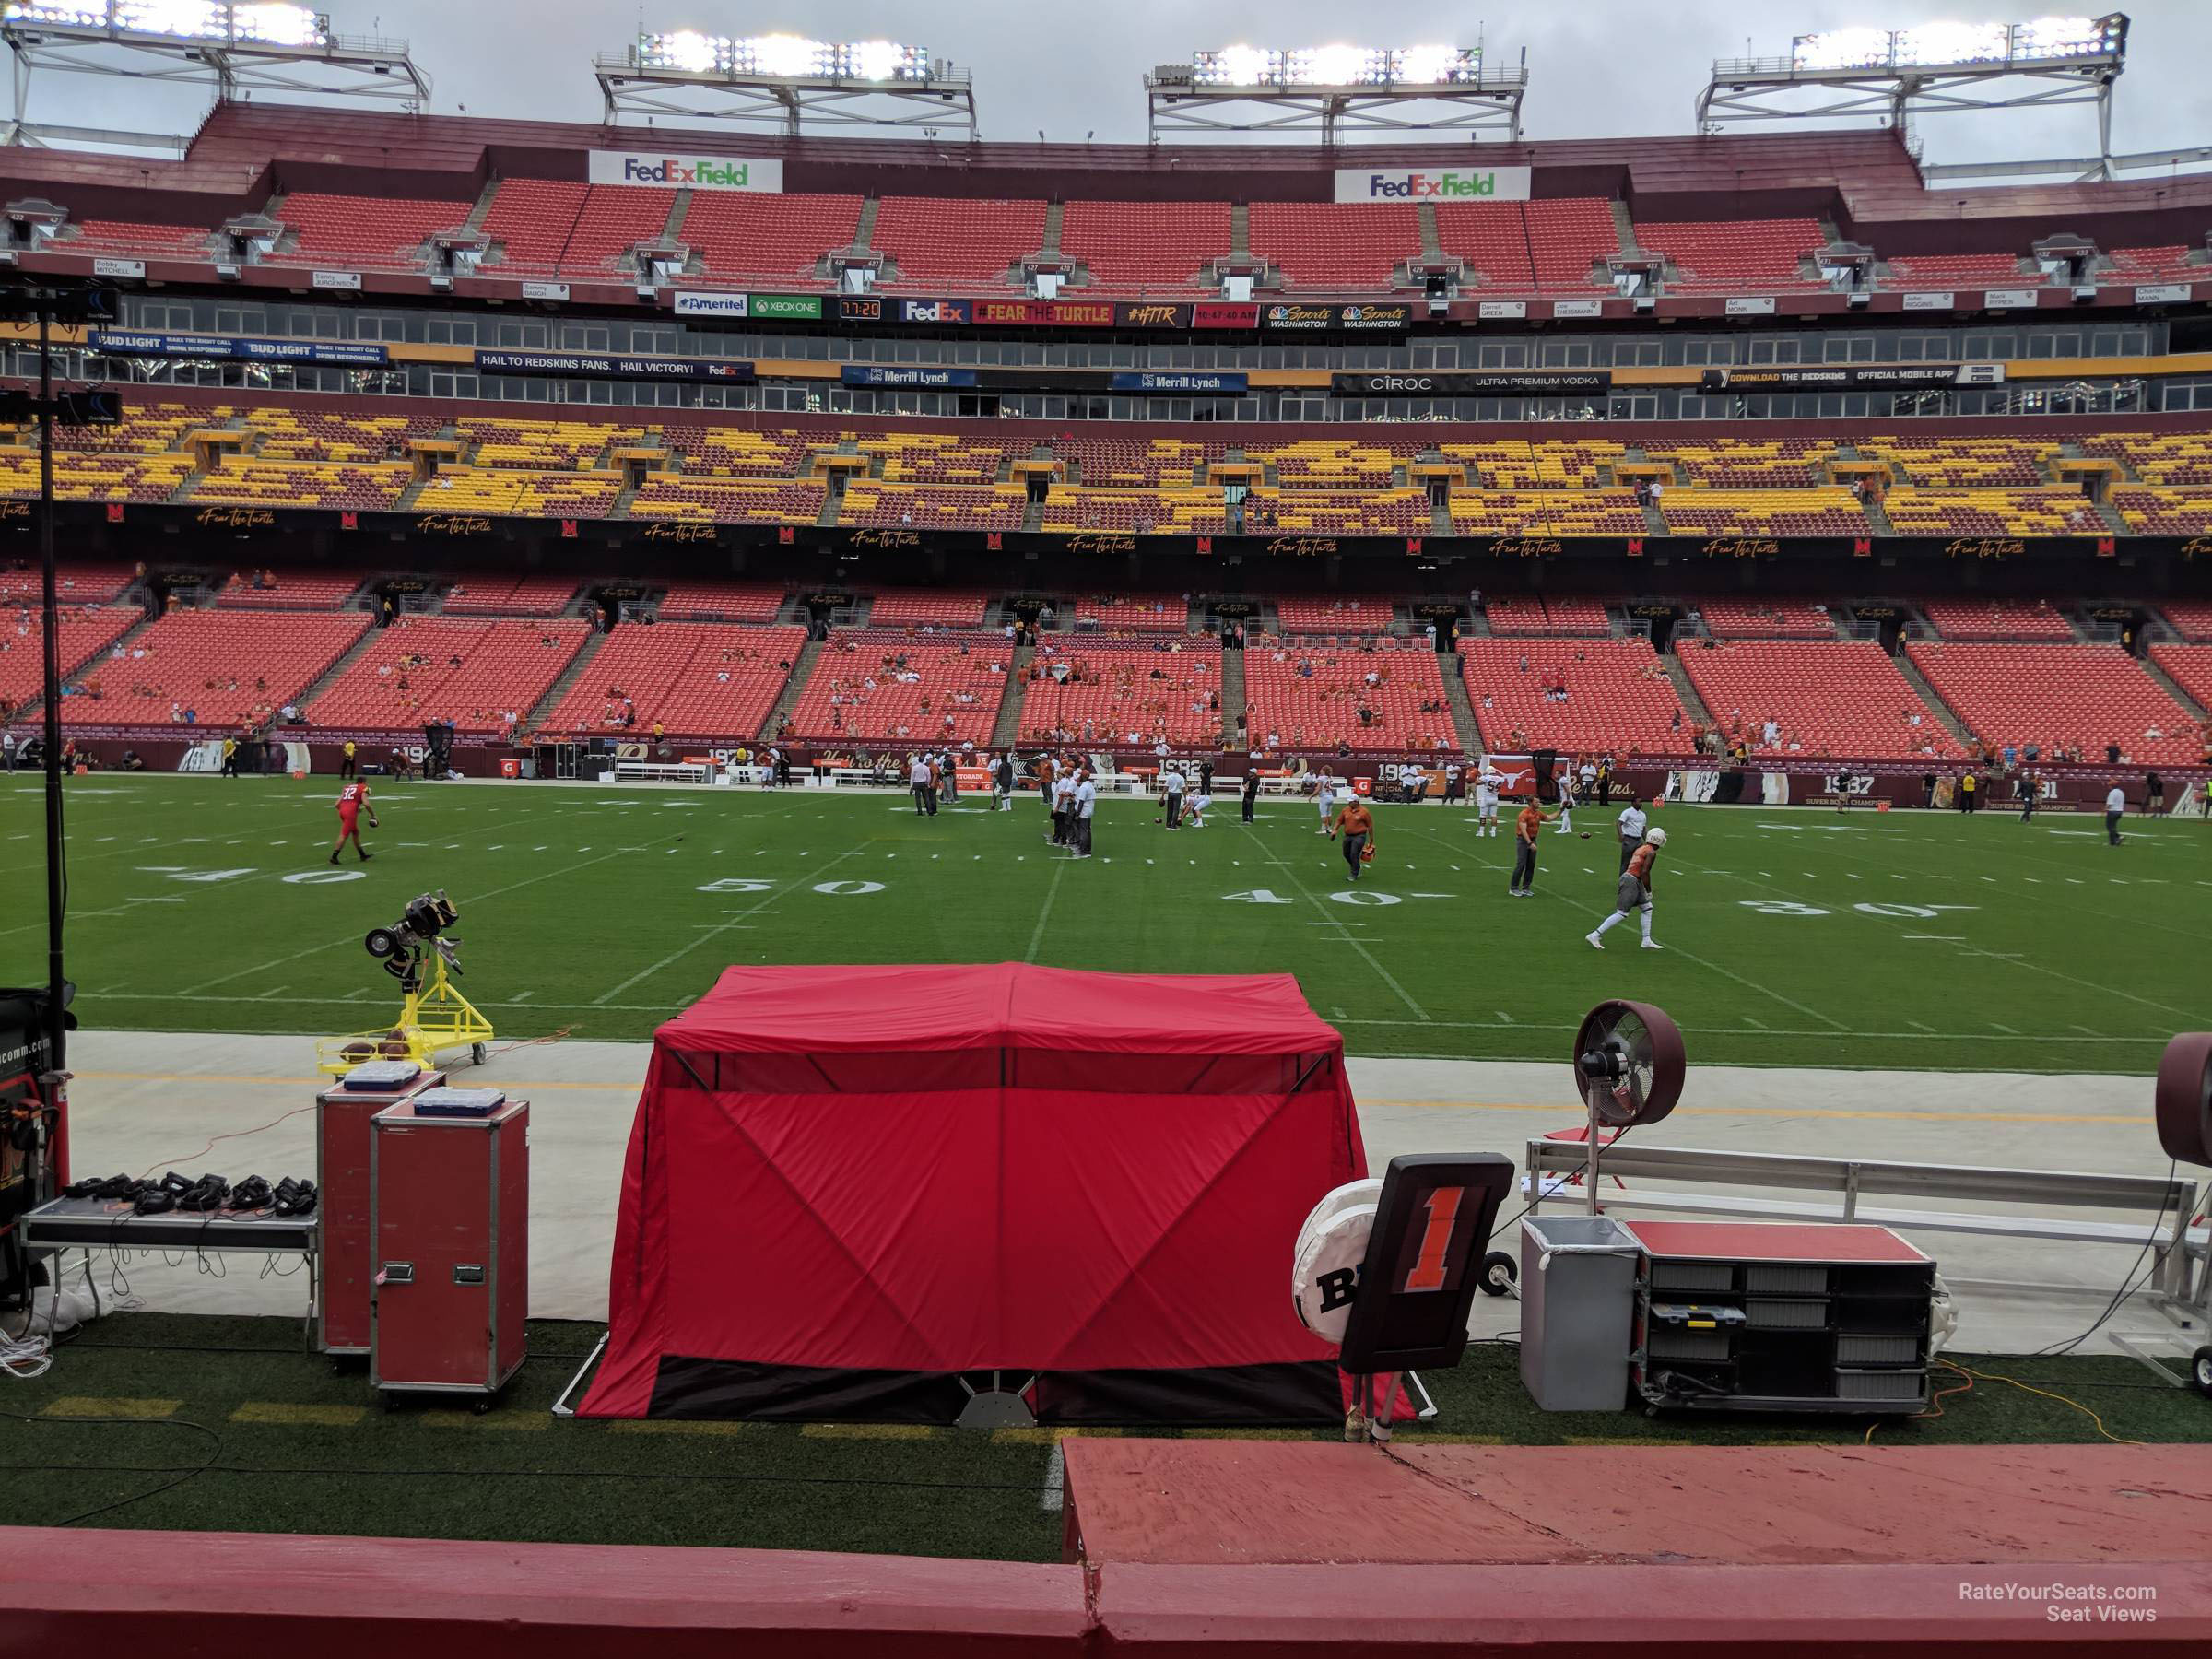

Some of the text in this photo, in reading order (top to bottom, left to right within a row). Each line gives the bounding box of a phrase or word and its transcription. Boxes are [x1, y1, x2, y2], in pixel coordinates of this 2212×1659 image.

[625, 158, 748, 185] FedExField
[1371, 173, 1495, 196] FedExField
[688, 297, 744, 311] Ameritel
[770, 302, 816, 312] XBOX ONE
[906, 301, 962, 321] FedEx
[1288, 306, 1330, 321] Sports
[1361, 306, 1405, 321] Sports
[125, 337, 160, 347] LIGHT
[250, 344, 311, 356] BUD LIGHT
[482, 356, 612, 371] HAIL TO REDSKINS FANS.
[620, 361, 693, 374] HAIL VICTORY!
[709, 365, 737, 376] FedEx
[884, 371, 949, 385] Merrill Lynch
[1476, 376, 1600, 386] ULTRA PREMIUM VODKA
[1730, 373, 1780, 382] DOWNLOAD
[1782, 372, 1798, 382] THE
[1857, 371, 1898, 380] OFFICIAL
[1899, 371, 1934, 380] MOBILE
[1935, 370, 1954, 379] APP
[1156, 376, 1221, 391] Merrill Lynch
[504, 762, 514, 773] G
[1359, 781, 1368, 791] G
[343, 788, 357, 799] 32
[0, 1037, 50, 1065] comm.com
[1404, 1187, 1465, 1292] 1
